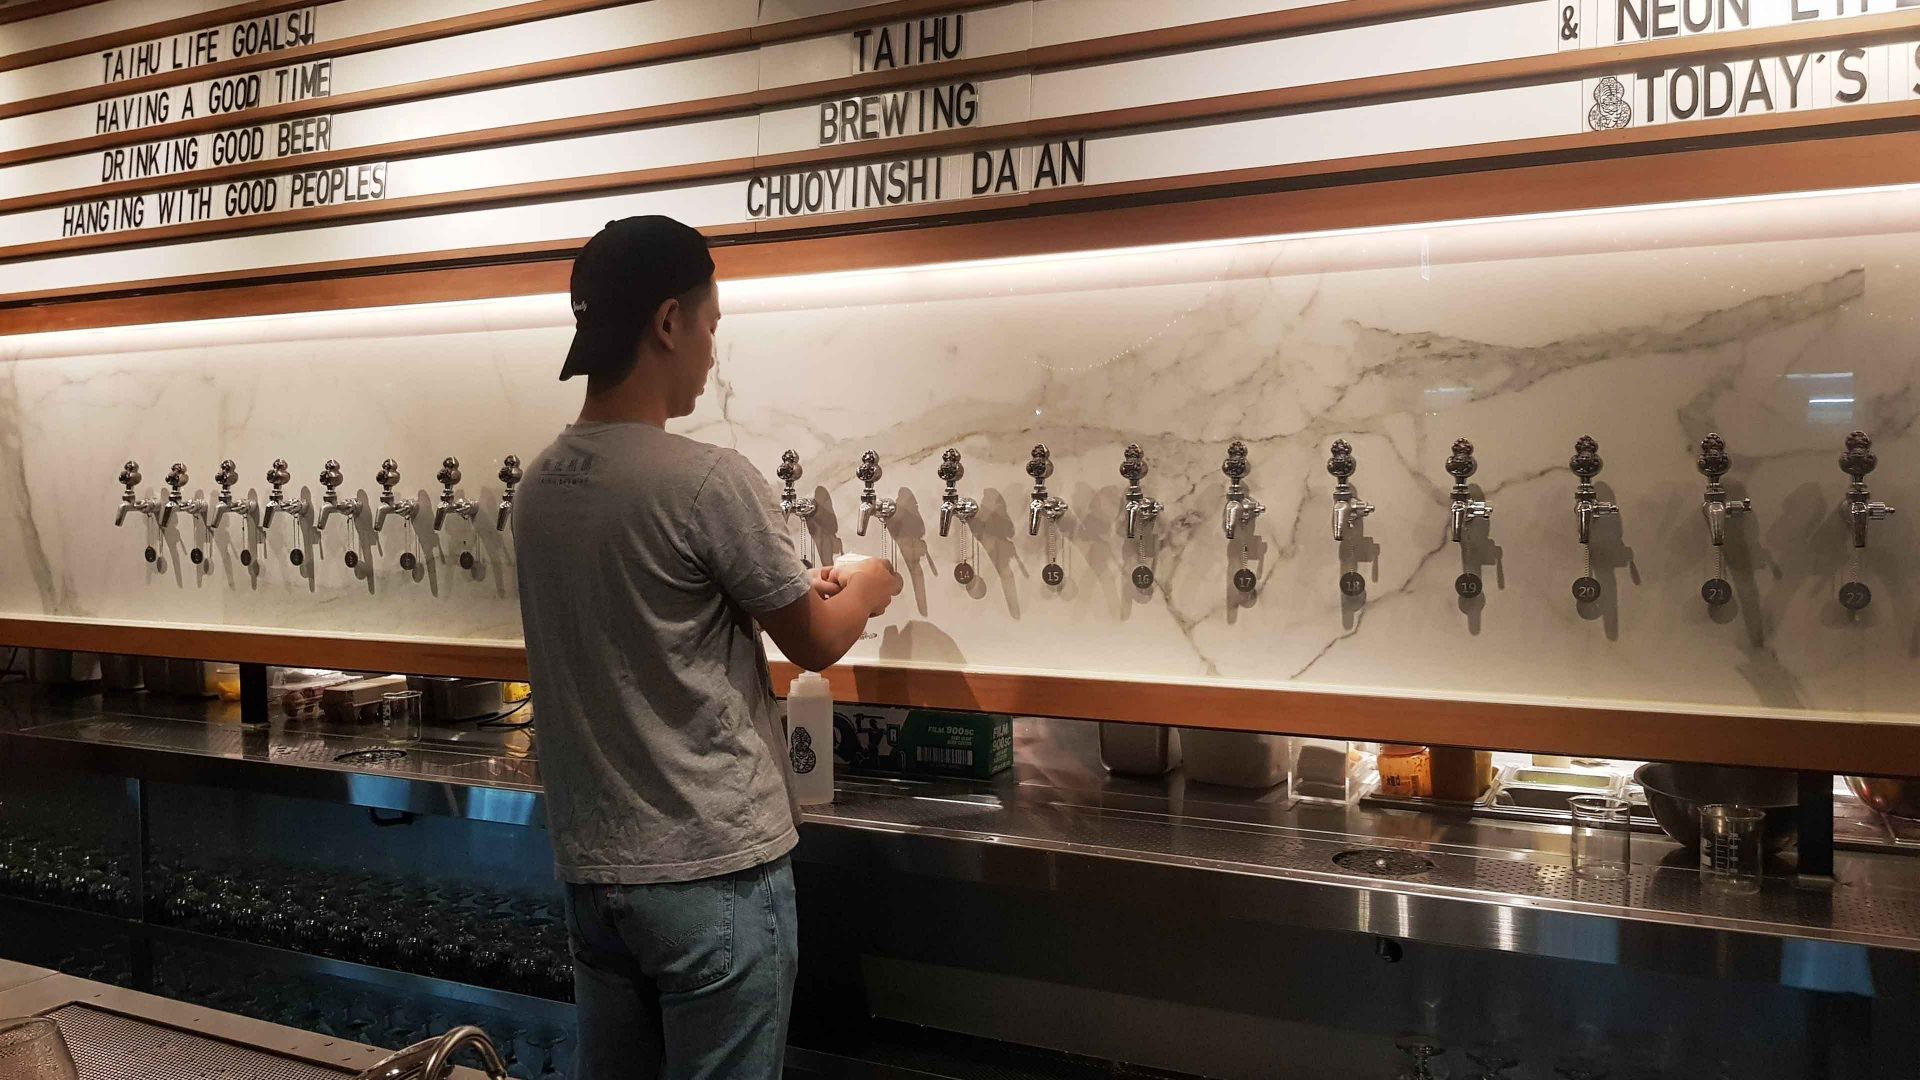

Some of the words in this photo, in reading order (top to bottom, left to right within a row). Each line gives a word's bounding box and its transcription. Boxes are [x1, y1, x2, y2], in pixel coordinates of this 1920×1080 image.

[853, 14, 963, 72] TAIHU
[1560, 5, 1579, 41] &
[1617, 0, 1750, 42] NEON
[102, 41, 161, 83] TAIHU
[172, 30, 220, 69] LIFE
[232, 13, 300, 57] GOALS
[96, 91, 170, 134] HAVING
[182, 87, 195, 119] A
[209, 74, 260, 115] GOOD
[275, 62, 330, 104] TIME
[1636, 48, 1868, 123] TODAY'S
[820, 82, 976, 145] BREWING
[101, 137, 198, 183] DRINKING
[213, 126, 264, 166] GOOD
[278, 116, 330, 157] BEER
[63, 196, 145, 237] HANGING
[158, 187, 212, 225] WITH
[225, 178, 277, 217] GOOD
[290, 165, 385, 209] PEOPLES
[747, 157, 942, 217] CHUOYINSHI
[972, 149, 1018, 195] DA
[1034, 139, 1085, 188] AN
[1047, 570, 1060, 582] 15
[1136, 574, 1150, 585] 16
[1239, 577, 1252, 588] 17
[1346, 580, 1360, 592] 18
[1461, 583, 1477, 594] 19
[1578, 586, 1596, 598] 20
[1847, 592, 1864, 604] 22
